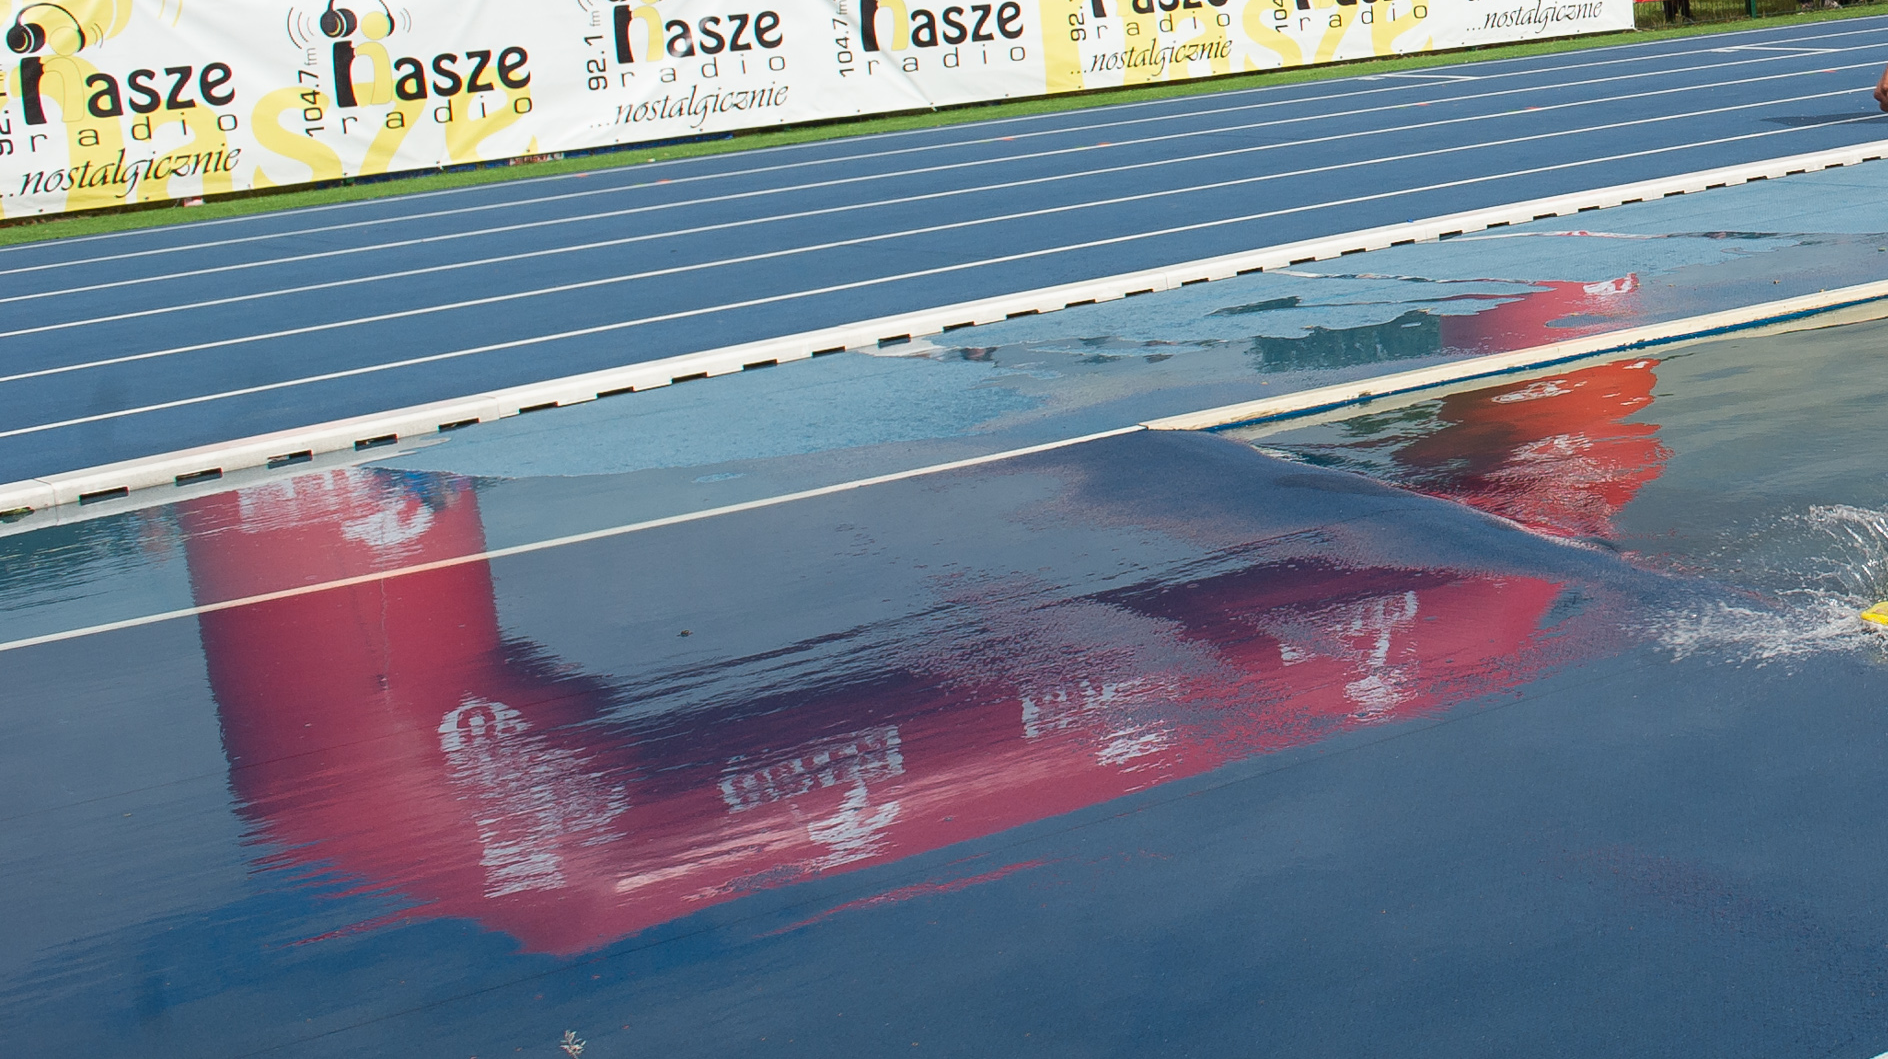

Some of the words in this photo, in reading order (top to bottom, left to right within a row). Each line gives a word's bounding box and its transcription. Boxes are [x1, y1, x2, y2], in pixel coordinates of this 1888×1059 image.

[1096, 10, 1231, 39] radio
[1299, 2, 1428, 32] radio
[584, 34, 608, 91] 92.1
[832, 18, 855, 78] 104.7
[867, 43, 1026, 75] radio
[621, 53, 786, 88] radio
[297, 68, 325, 137] 104.7
[341, 95, 533, 135] radio
[31, 112, 238, 153] radio
